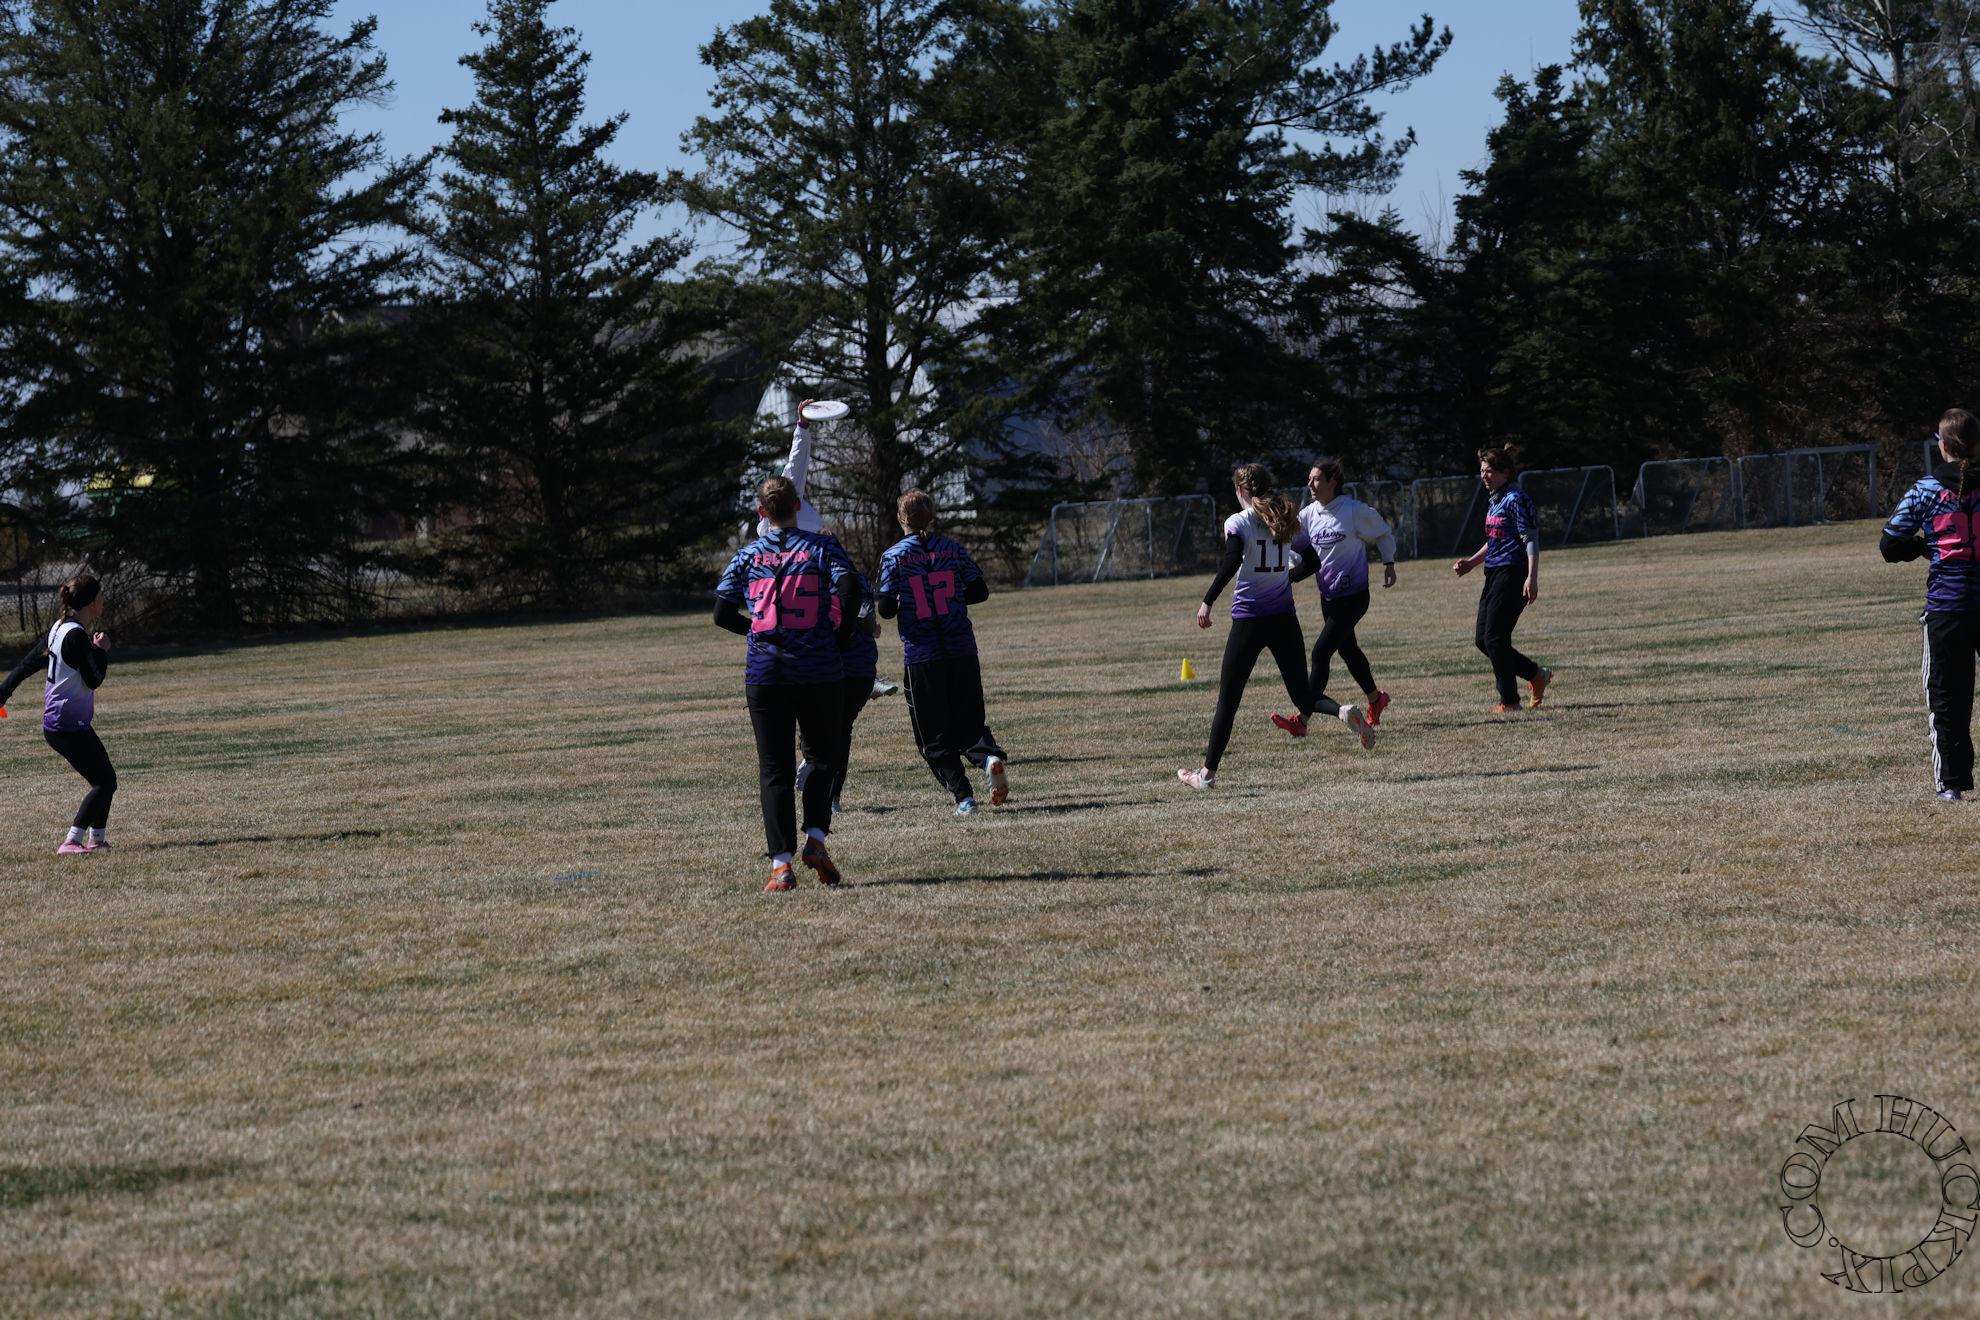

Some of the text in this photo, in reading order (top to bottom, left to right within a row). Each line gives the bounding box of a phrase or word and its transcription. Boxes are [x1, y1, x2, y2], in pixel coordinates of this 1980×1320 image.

[1254, 539, 1286, 573] 11
[749, 574, 819, 634] 35
[908, 569, 955, 620] 17
